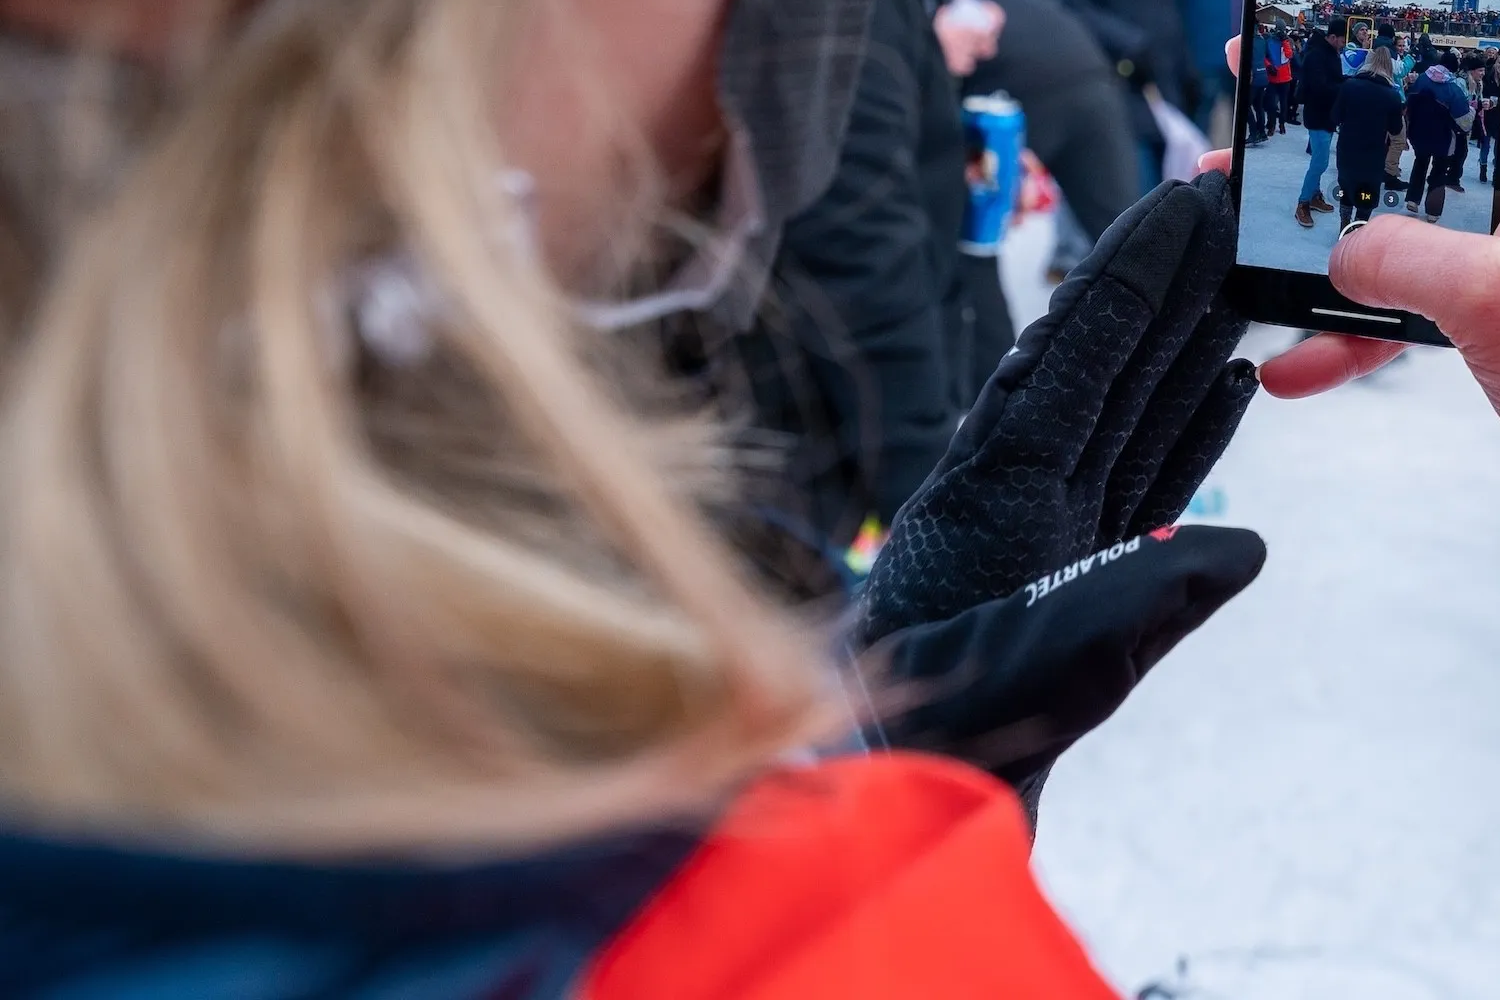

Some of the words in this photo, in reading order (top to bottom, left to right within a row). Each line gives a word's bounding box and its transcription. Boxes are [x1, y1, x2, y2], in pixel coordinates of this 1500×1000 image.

[1336, 190, 1344, 198] .5
[1388, 195, 1394, 203] 3
[1024, 535, 1140, 608] POLARTEC
